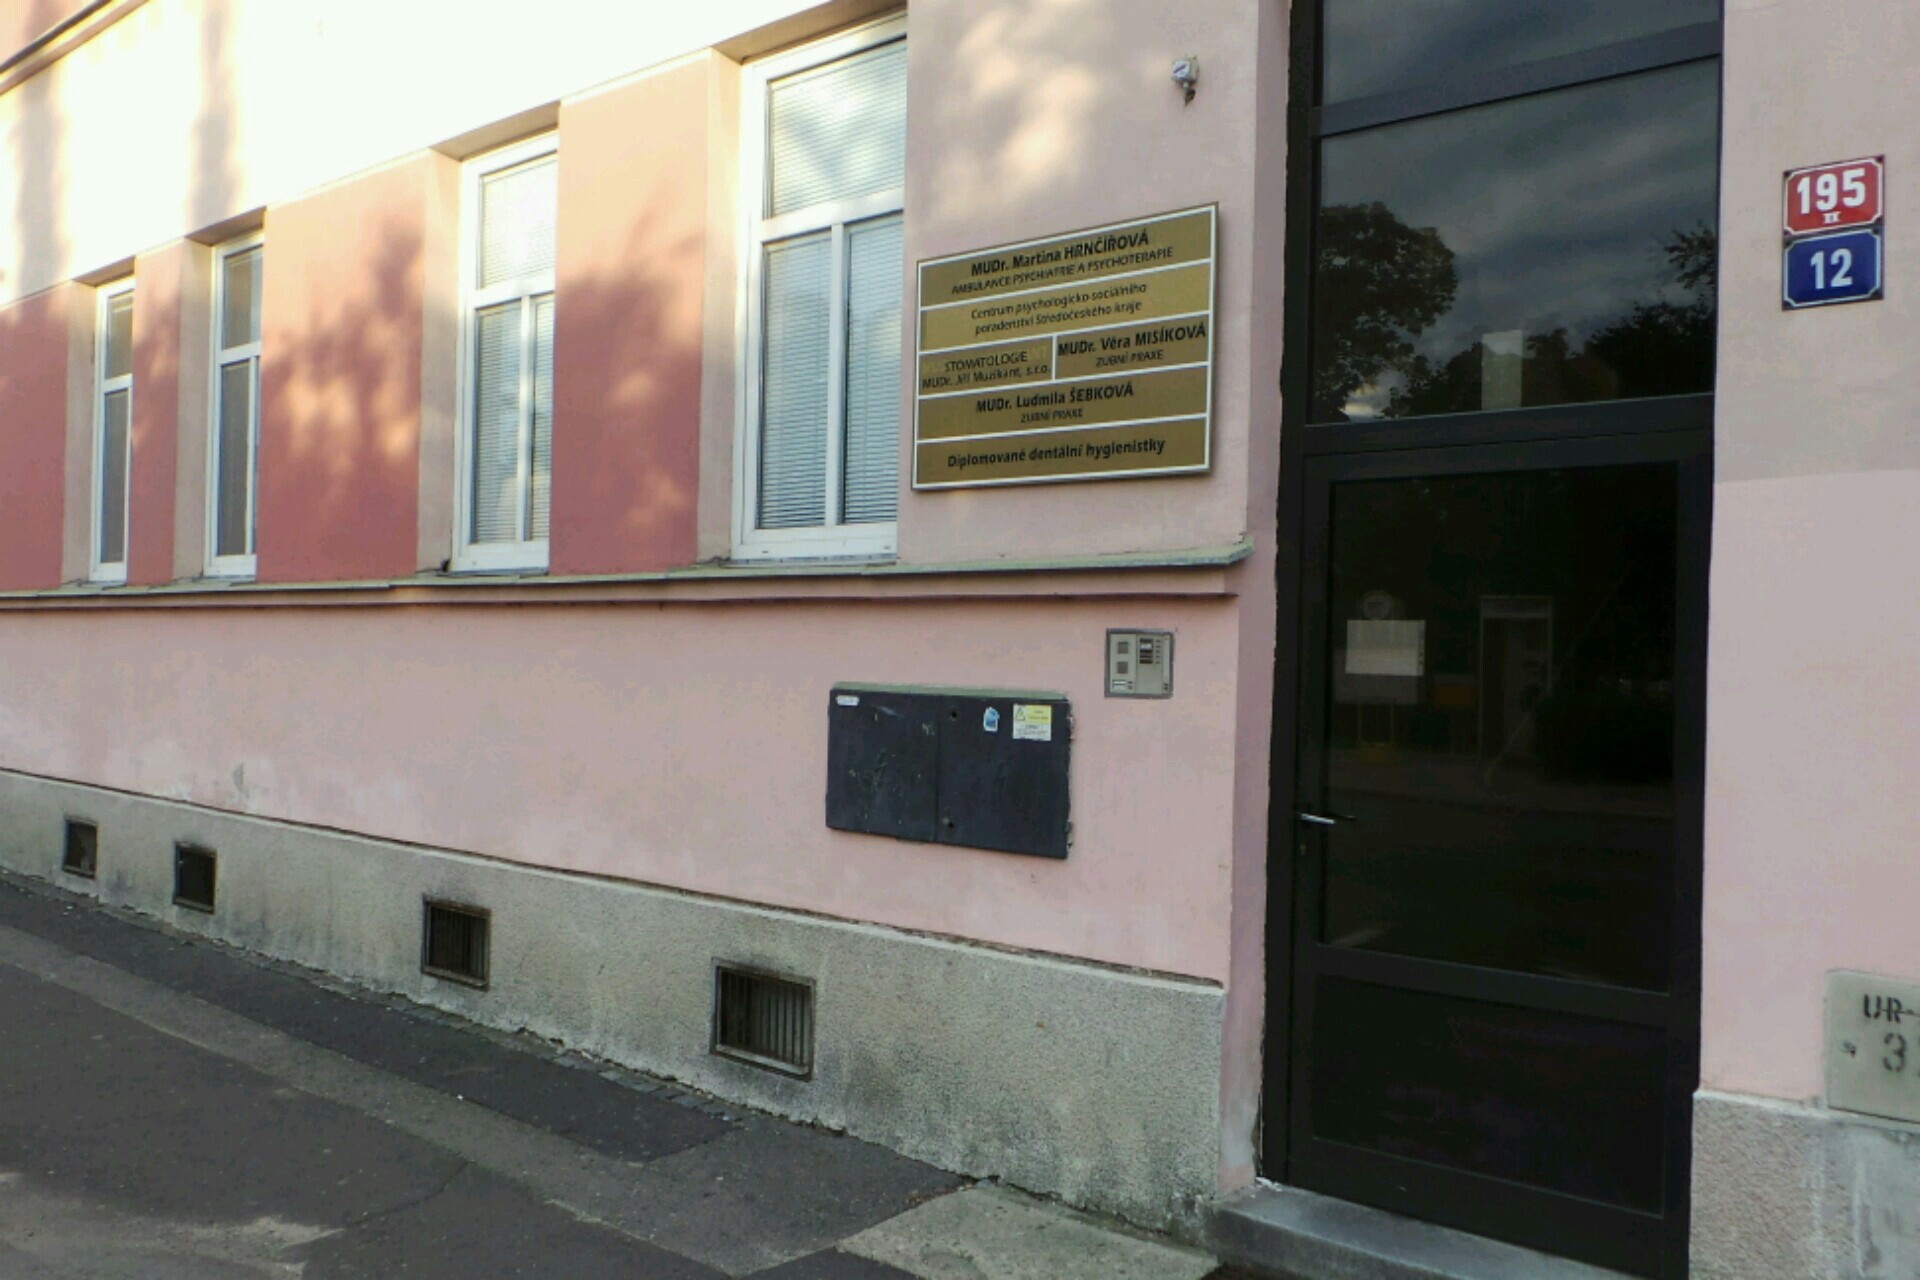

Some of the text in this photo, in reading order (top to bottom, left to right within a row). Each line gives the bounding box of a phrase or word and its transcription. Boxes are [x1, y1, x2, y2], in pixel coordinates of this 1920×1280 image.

[1797, 168, 1866, 214] 195
[951, 246, 1174, 294] AMBULANCE PSYCHIATRIE A PSYCHOTERAPIE
[971, 260, 1009, 276] MUDr.
[1012, 250, 1062, 268] Martina
[1810, 248, 1853, 289] 12
[971, 306, 1014, 320] Centrum
[975, 300, 1142, 336] poradenství Středočeského kraje
[1058, 340, 1096, 356] MUDr.
[1100, 334, 1131, 350] Věra
[1096, 349, 1164, 367] ZUBNÍ PRAXE
[944, 351, 1028, 373] STOMATOLOGIE
[922, 376, 952, 389] MUDr.
[1026, 363, 1052, 375] s.r.o.
[975, 382, 1134, 413] MUDr. Ludmila ŠEBKOVÁ
[1020, 408, 1083, 423] ZUBNÍ PRAXE
[947, 437, 1166, 470] Diplomované dentální hygienistky
